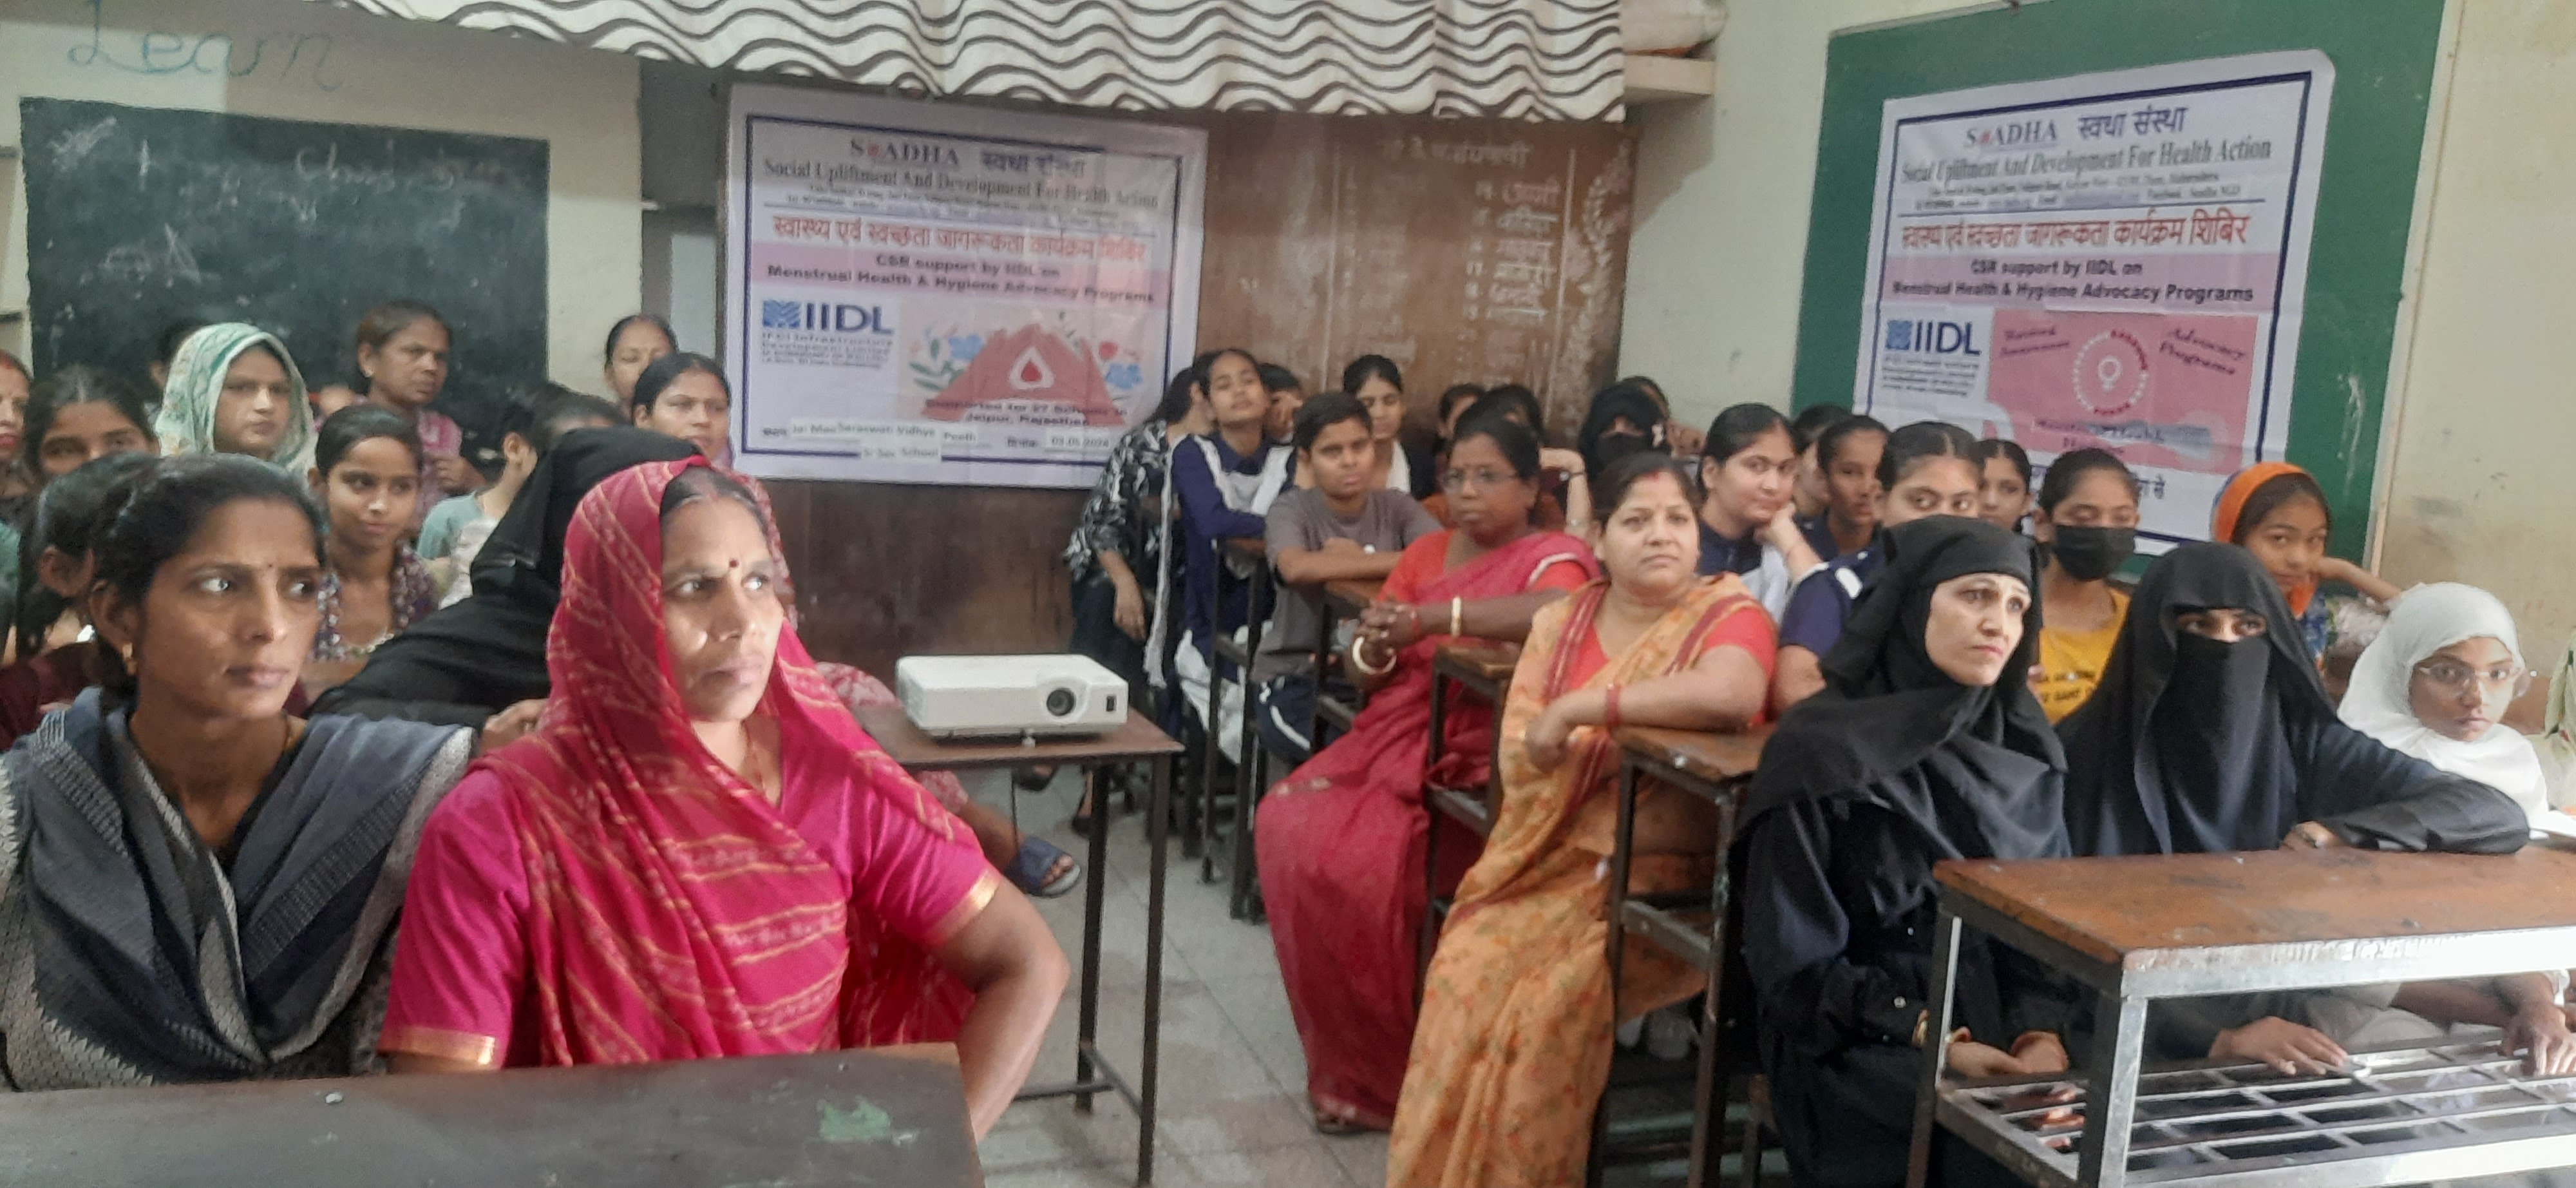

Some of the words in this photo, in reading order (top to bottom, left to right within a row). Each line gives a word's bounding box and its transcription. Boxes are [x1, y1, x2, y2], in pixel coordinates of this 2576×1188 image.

[2078, 114, 2126, 140] स्वधा
[2132, 104, 2188, 135] संस्था
[2128, 145, 2155, 168] For
[2159, 140, 2213, 166] Health
[2218, 135, 2272, 161] Action
[767, 265, 853, 282] Menstrual
[858, 271, 912, 284] Health
[936, 277, 999, 292] Hygiene
[1084, 286, 1154, 302] Programs
[982, 262, 999, 276] by
[2063, 260, 2081, 278] by
[2123, 263, 2143, 275] on
[2002, 282, 2011, 295] &
[2016, 282, 2077, 300] Hygiene
[2081, 282, 2160, 303] Advocacy
[2166, 284, 2253, 304] Programs
[806, 303, 895, 335] IIDL
[1914, 320, 1982, 356] IIDL
